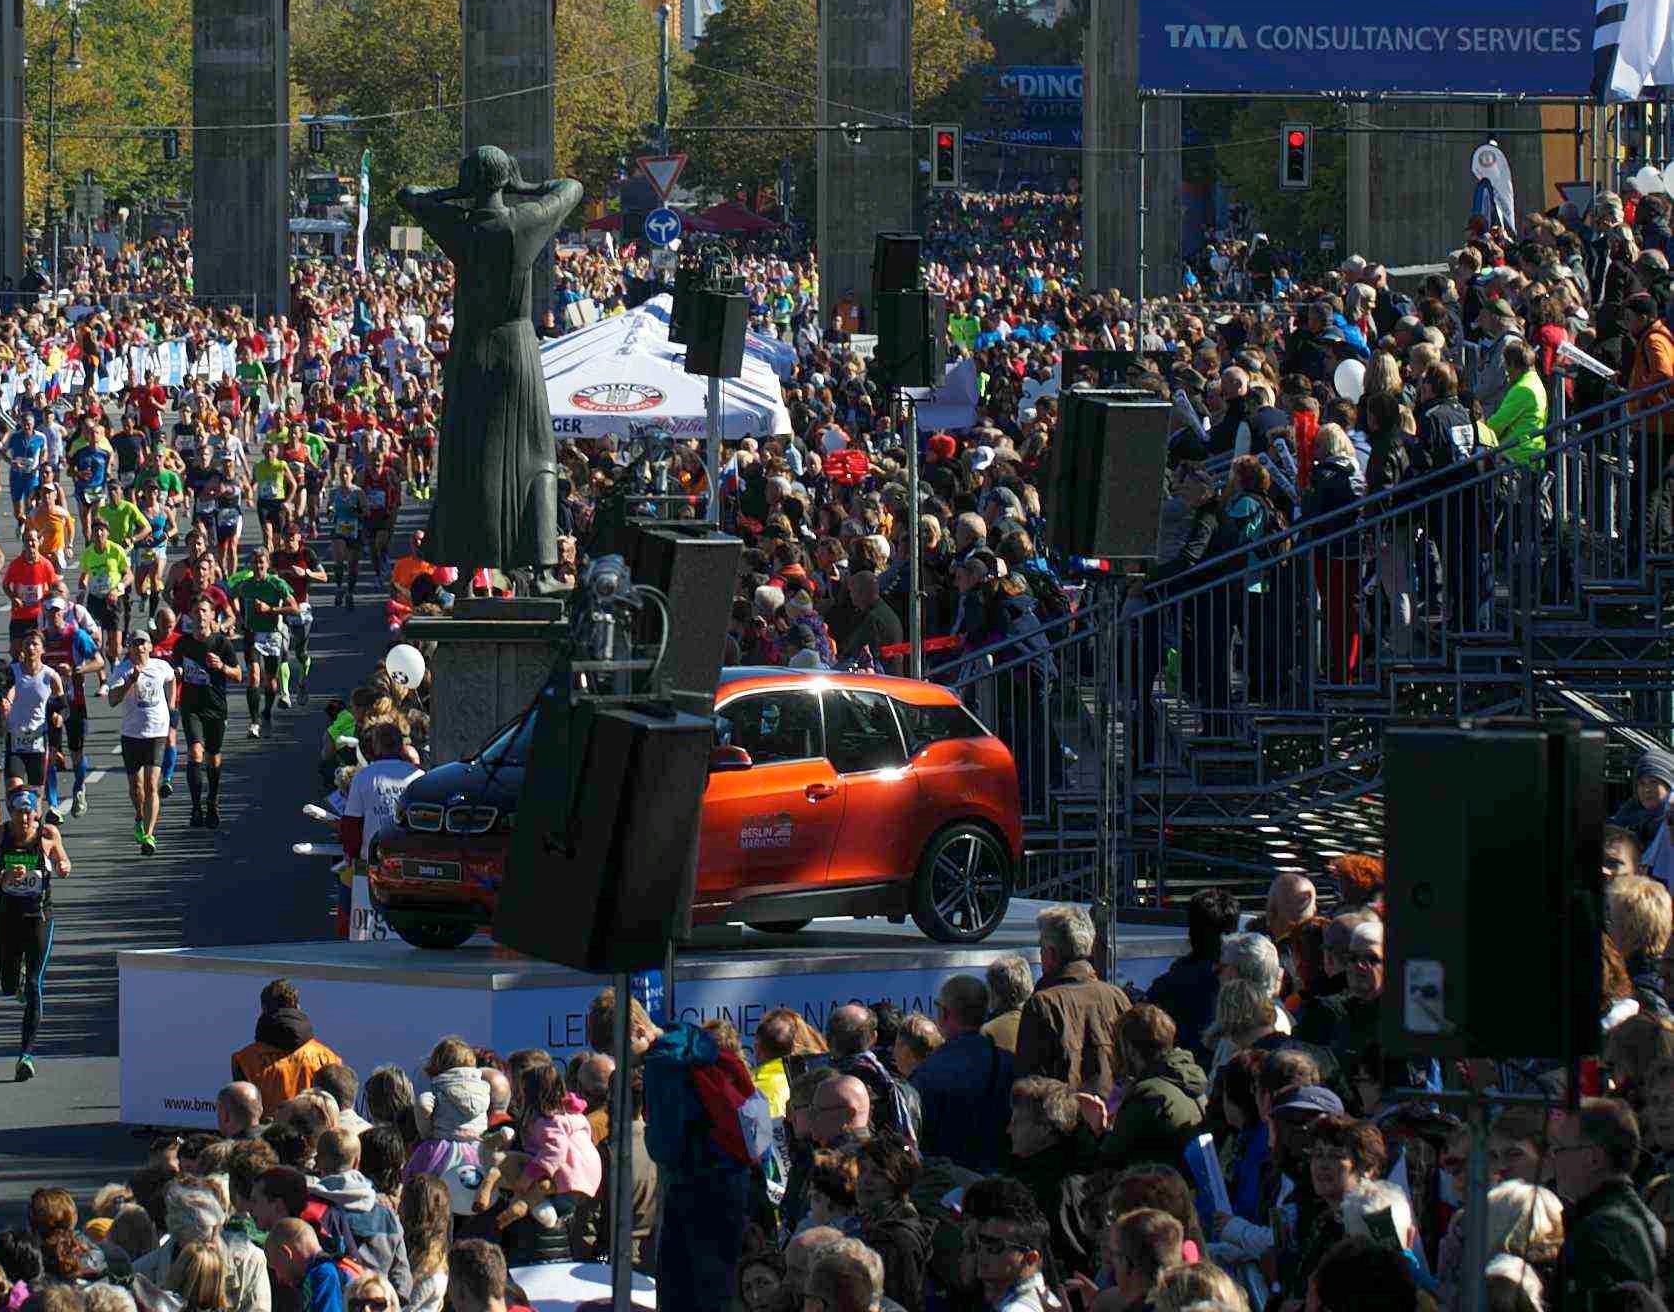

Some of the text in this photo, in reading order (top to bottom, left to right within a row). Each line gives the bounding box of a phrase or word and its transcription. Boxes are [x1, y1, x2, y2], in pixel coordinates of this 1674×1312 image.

[1164, 24, 1582, 53] TATA CONSULTANCY SERVICES
[741, 827, 774, 838] BERLIN
